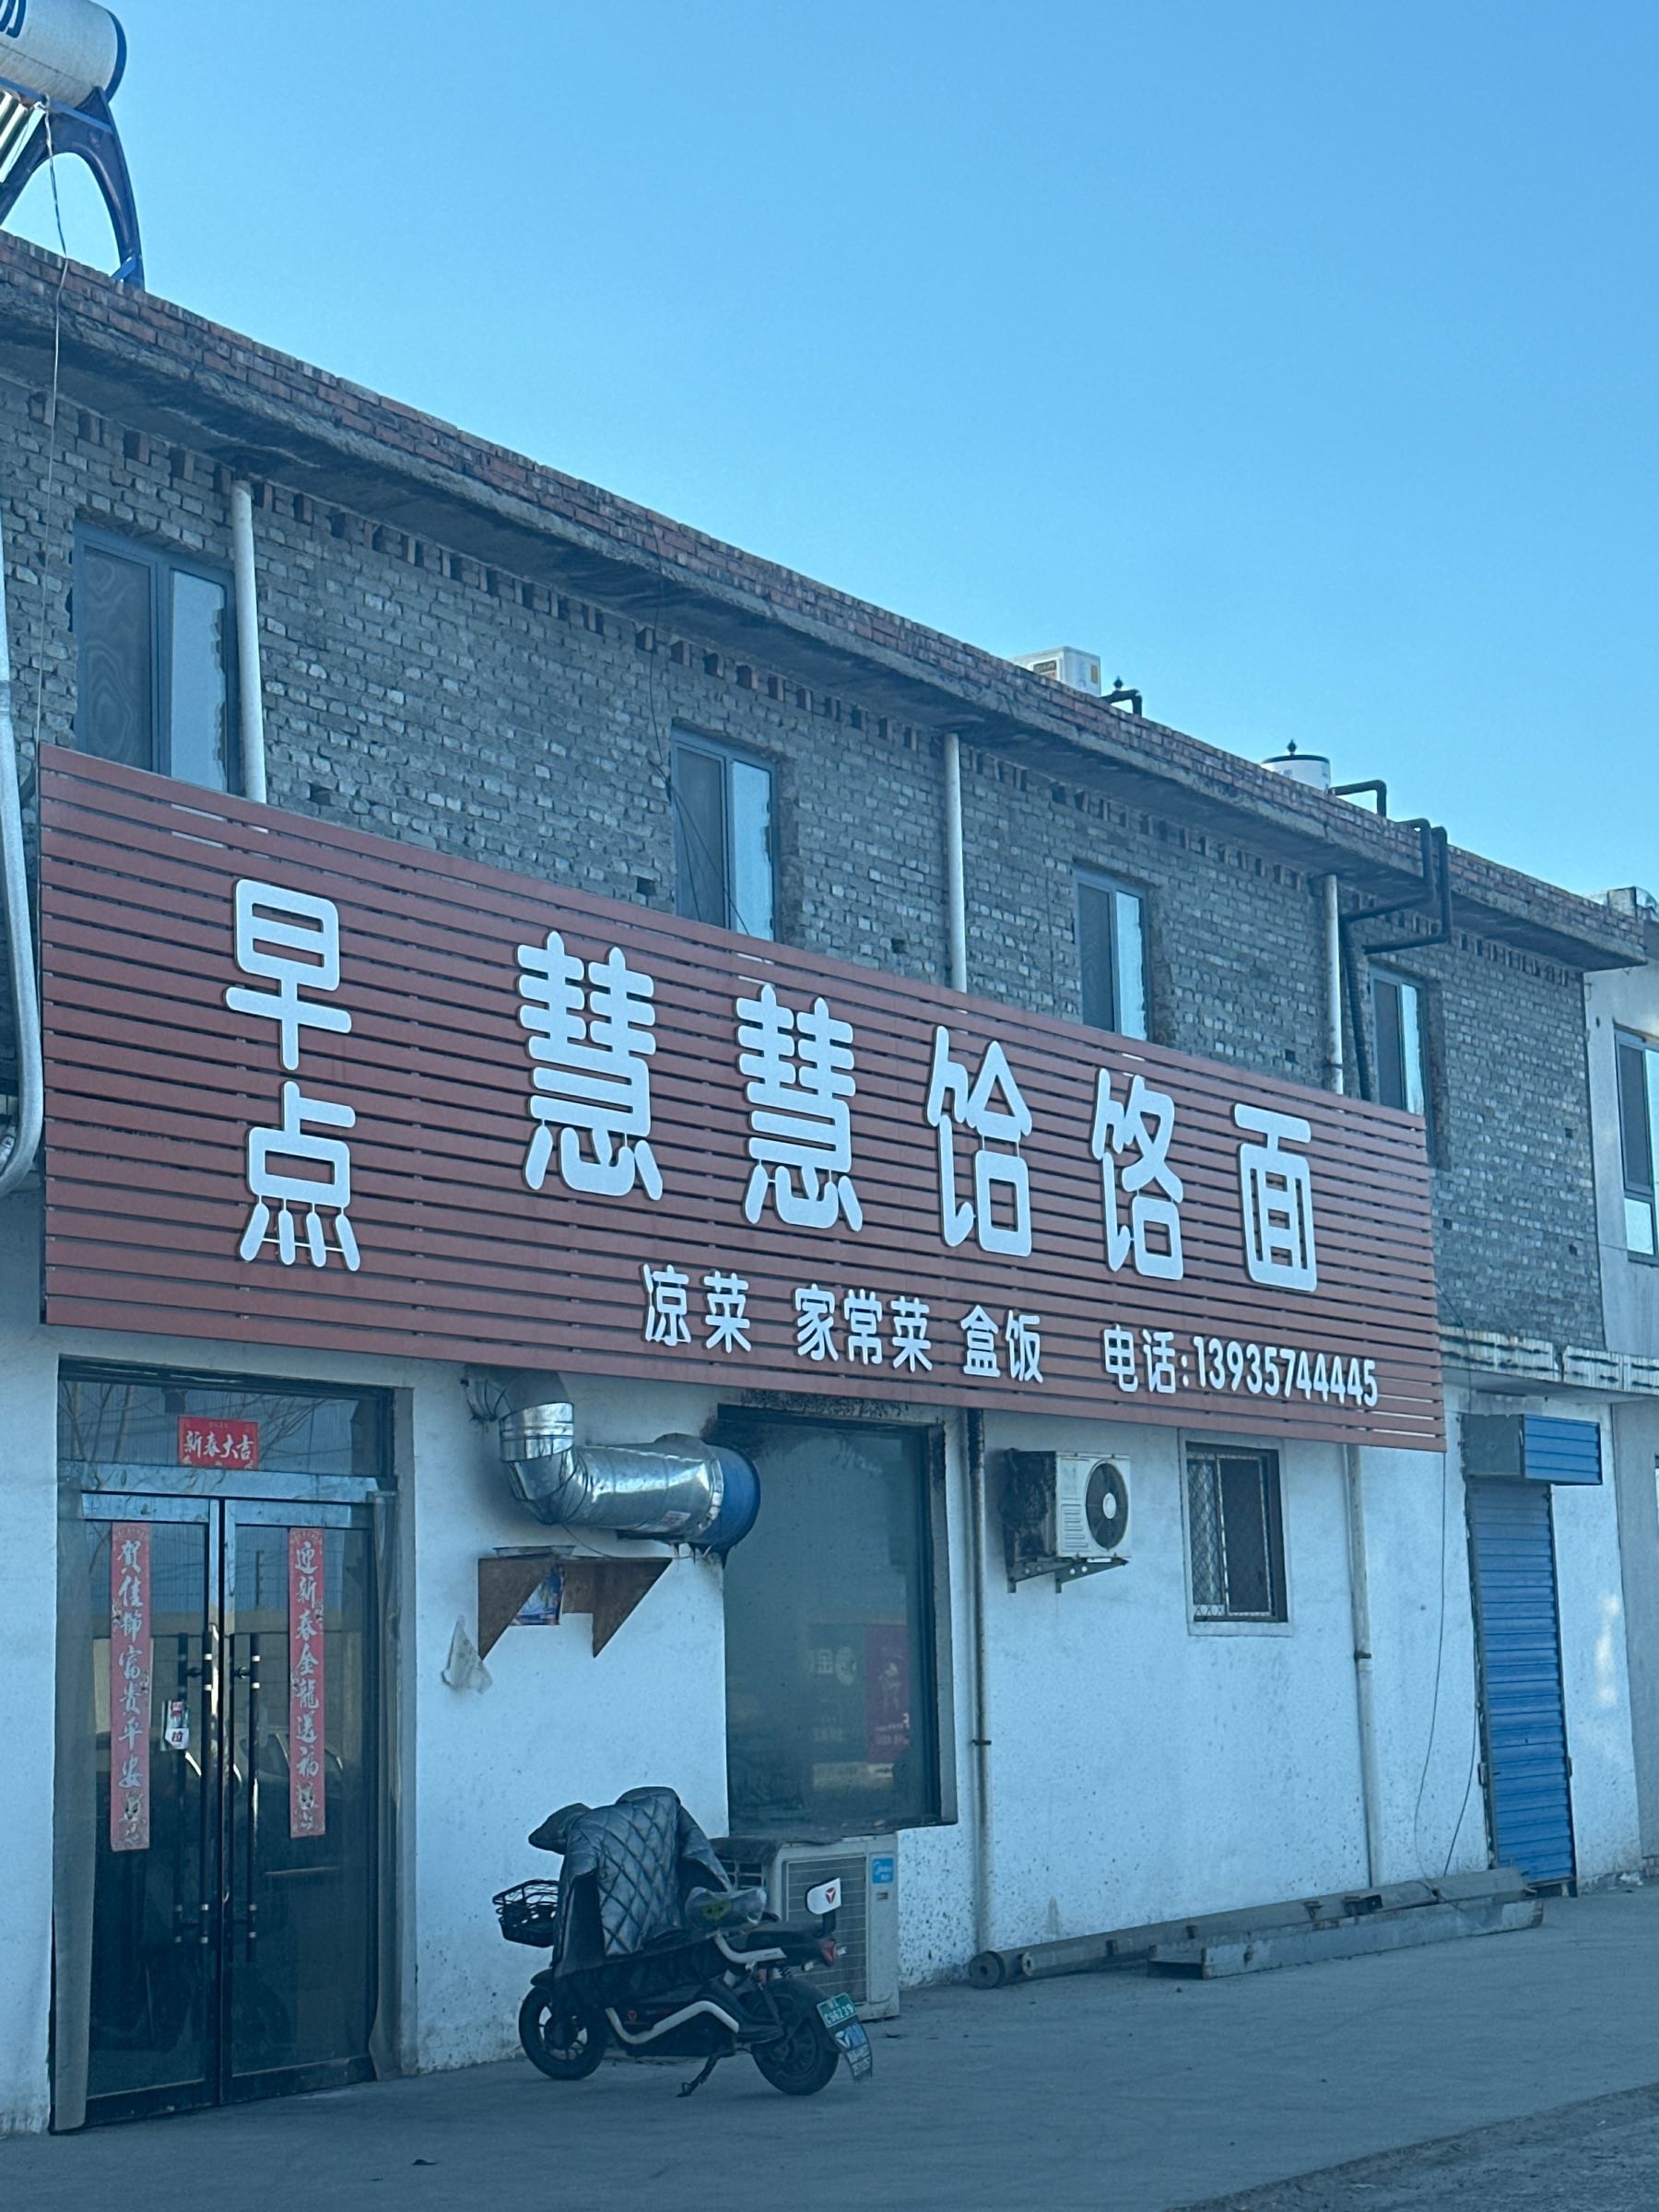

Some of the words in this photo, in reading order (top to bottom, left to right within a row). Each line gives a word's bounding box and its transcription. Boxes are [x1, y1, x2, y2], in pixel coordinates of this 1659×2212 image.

[225, 878, 360, 1272] 早点
[514, 930, 1319, 1293] 慧慧饸饹面
[642, 1263, 752, 1354] 凉菜
[794, 1283, 934, 1373] 家常菜
[959, 1304, 1044, 1383] 盒饭
[183, 1430, 254, 1461] 新春大吉
